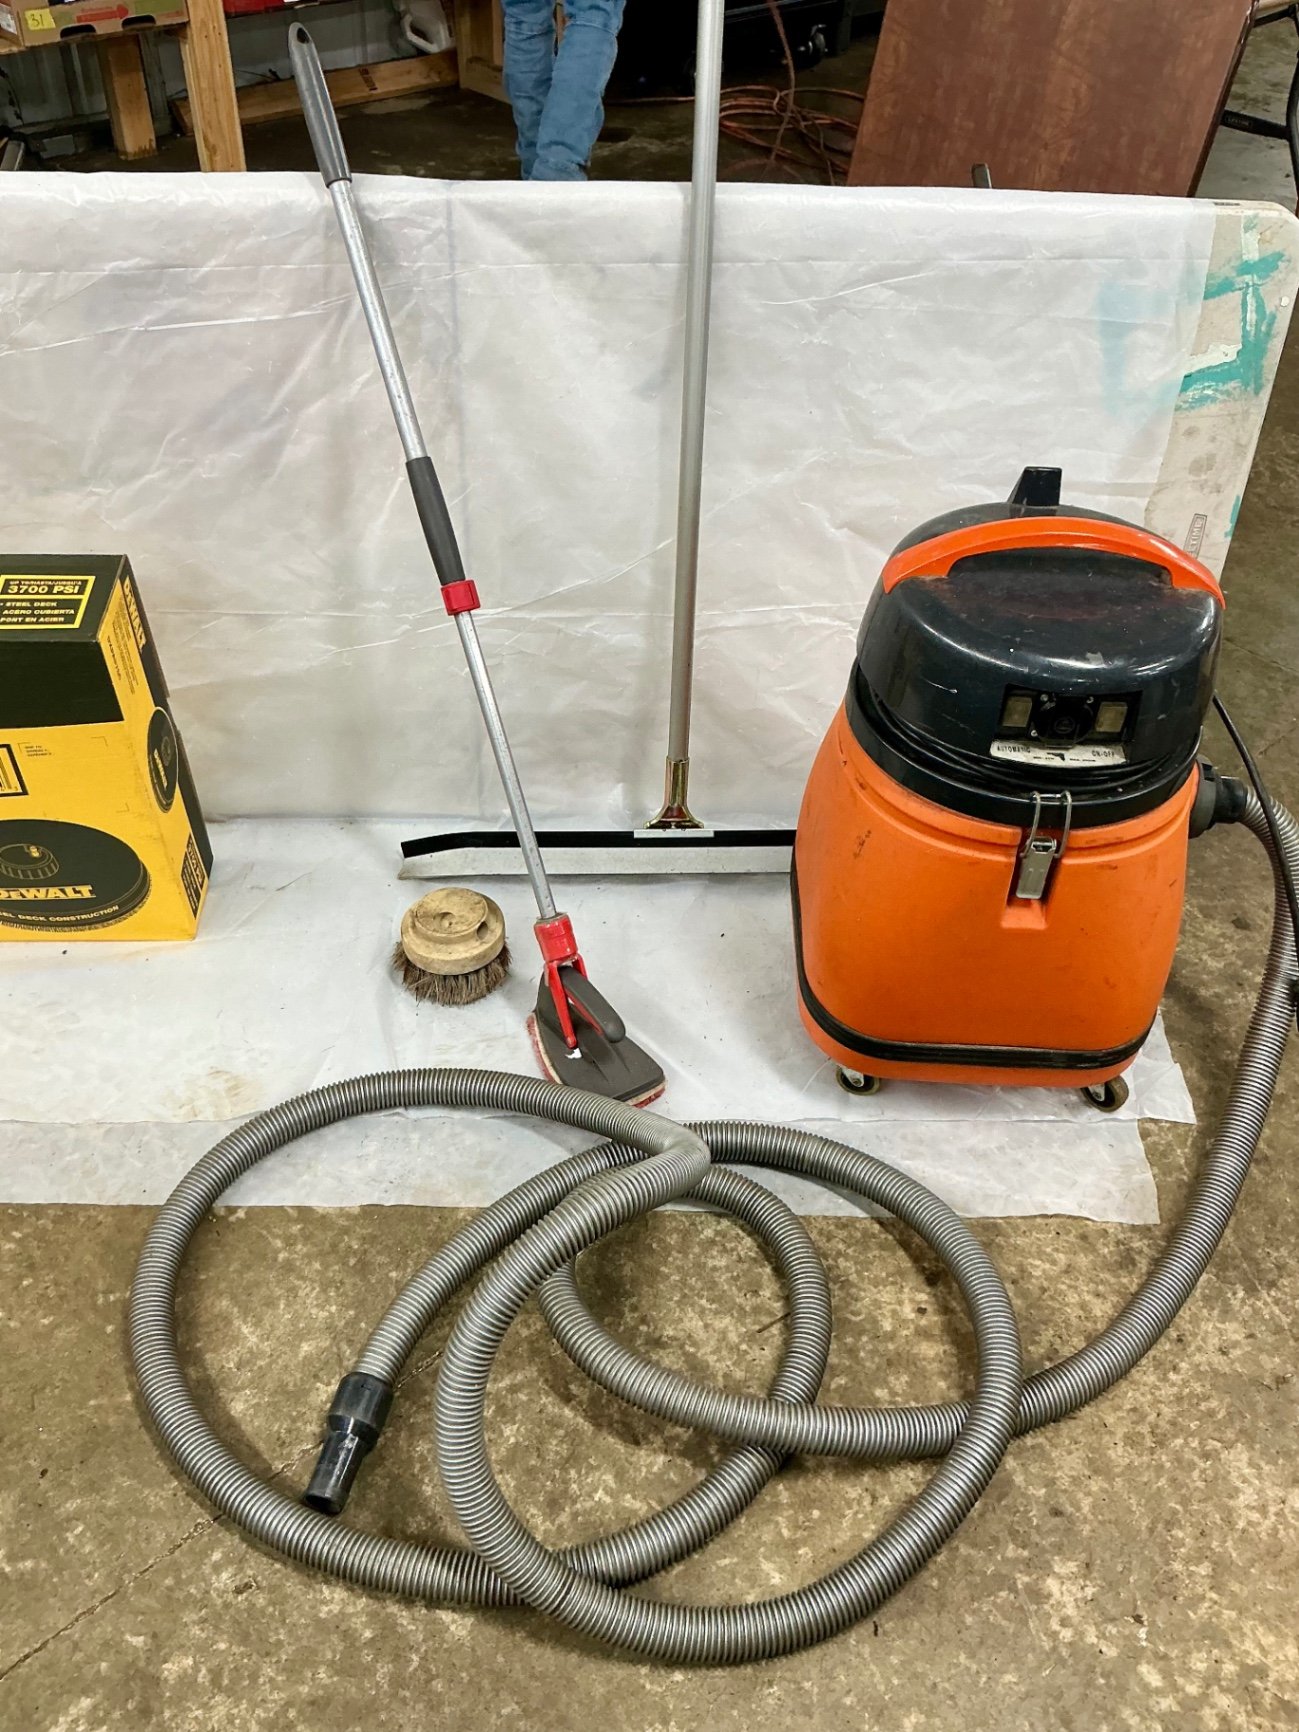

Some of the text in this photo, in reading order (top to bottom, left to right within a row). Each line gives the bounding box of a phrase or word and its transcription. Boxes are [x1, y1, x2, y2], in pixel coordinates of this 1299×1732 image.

[30, 13, 44, 27] 31
[8, 585, 79, 594] 3700 PSI
[997, 745, 1031, 754] AUTOMATIC
[49, 905, 119, 921] CONSTRUCTION
